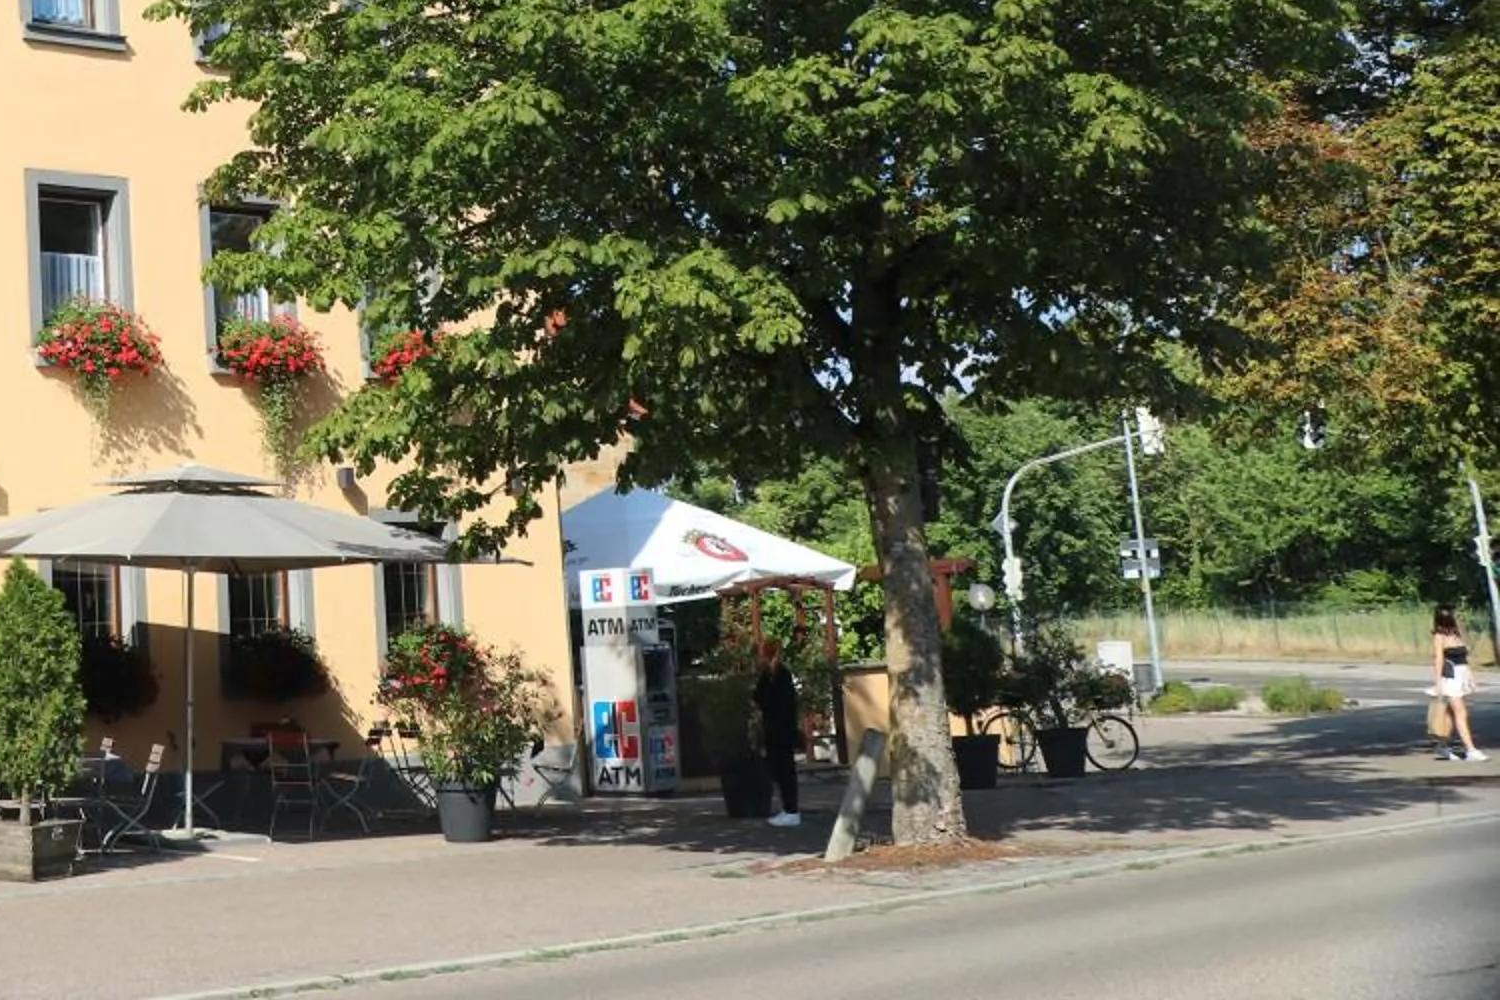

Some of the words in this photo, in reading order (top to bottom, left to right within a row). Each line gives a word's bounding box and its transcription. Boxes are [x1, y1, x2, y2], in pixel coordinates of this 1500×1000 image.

[588, 617, 625, 636] ATM
[631, 617, 656, 632] ATM
[598, 766, 641, 786] ATM
